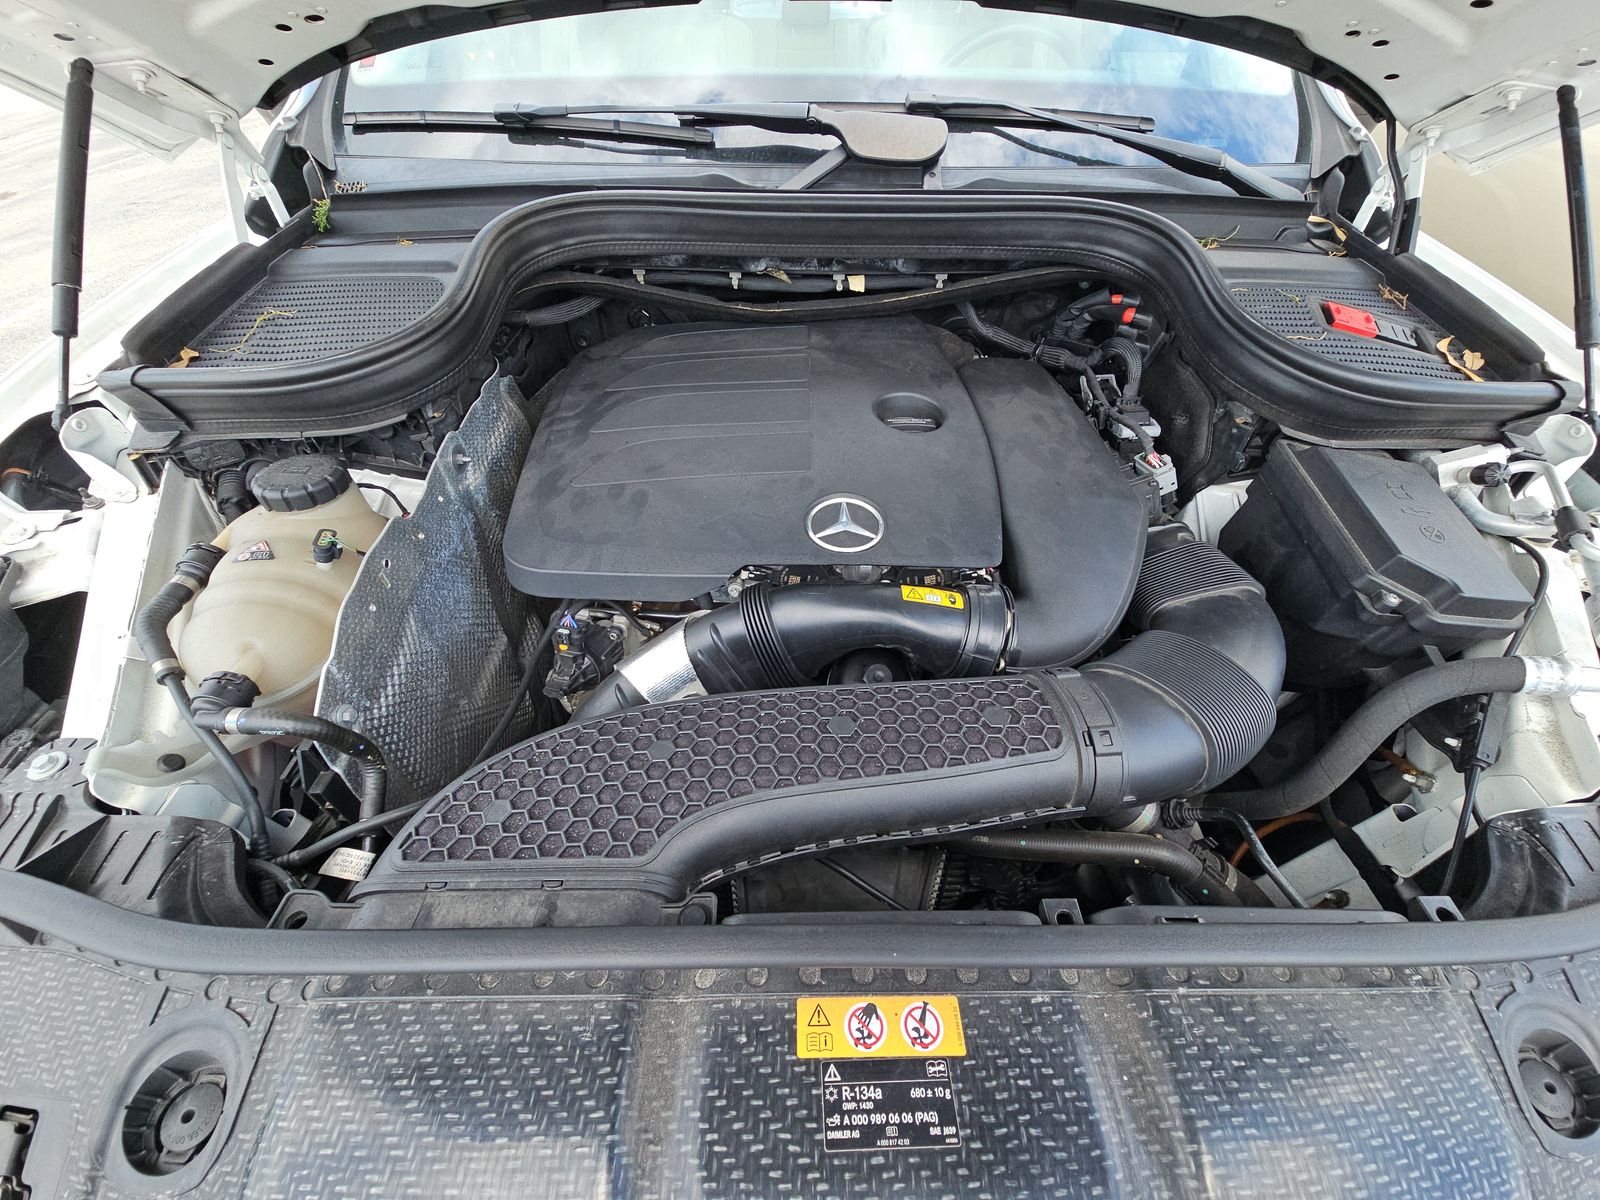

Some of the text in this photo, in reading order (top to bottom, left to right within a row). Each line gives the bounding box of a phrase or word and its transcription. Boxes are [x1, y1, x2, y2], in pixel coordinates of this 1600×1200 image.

[842, 1085, 883, 1101] R-134a
[910, 1088, 925, 1098] 680
[934, 1087, 944, 1098] 10
[945, 1089, 951, 1099] g
[859, 1102, 874, 1110] 1430
[843, 1111, 939, 1125] A 000 989 06 06 (PAG)
[827, 1130, 860, 1139] DAIMLER AG
[929, 1126, 957, 1135] SAE J639
